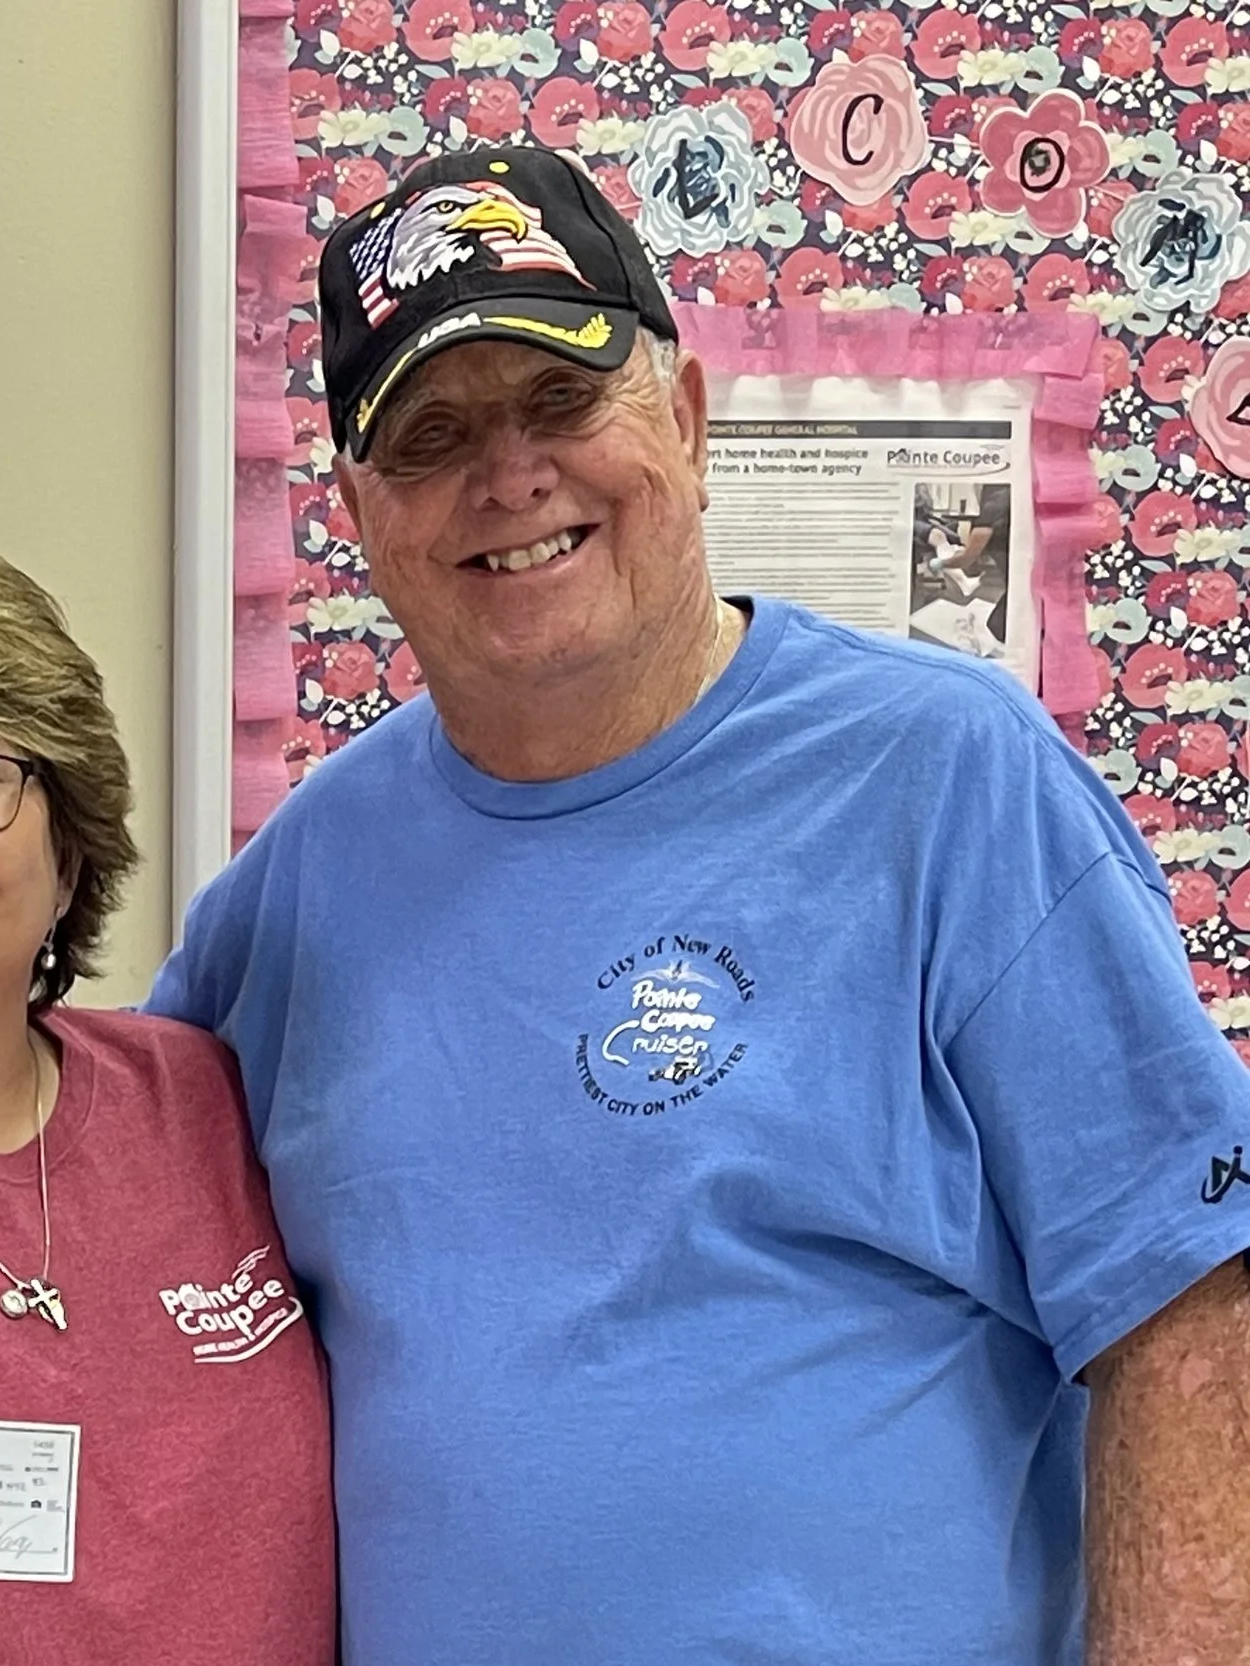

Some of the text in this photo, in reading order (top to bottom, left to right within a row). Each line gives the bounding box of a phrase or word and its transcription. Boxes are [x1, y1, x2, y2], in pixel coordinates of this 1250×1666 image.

[840, 93, 884, 166] C
[1019, 137, 1065, 193] O
[774, 424, 815, 436] GENERAL
[816, 424, 859, 436] HOSPITAL
[712, 462, 862, 477] from a home-town agency
[725, 447, 757, 458] home
[760, 447, 797, 458] health
[800, 447, 821, 458] and
[824, 447, 869, 461] hospice
[886, 447, 1000, 468] Pointe Coupee
[596, 933, 756, 1004] City of New Roads
[631, 979, 703, 1010] Pointe
[601, 1019, 708, 1067] Cruiser
[574, 1033, 749, 1116] PRETTIEST CITY ON THE WATER
[158, 1272, 254, 1316] Pointe
[175, 1278, 286, 1341] Coupee
